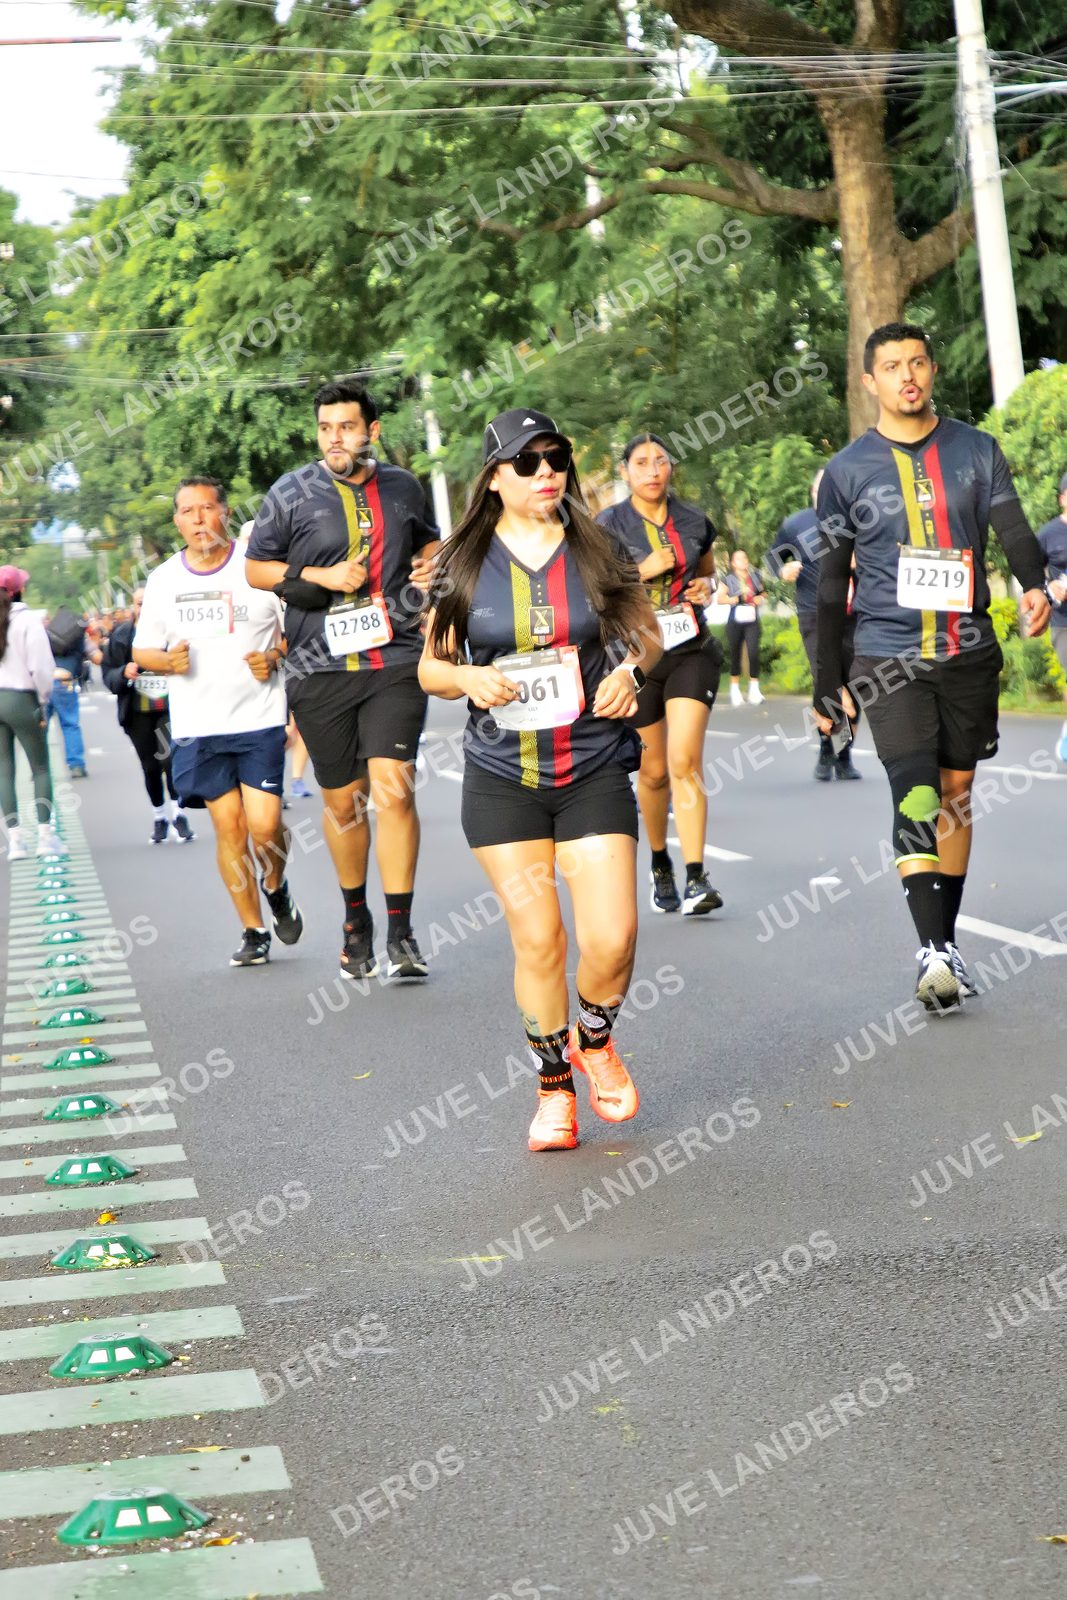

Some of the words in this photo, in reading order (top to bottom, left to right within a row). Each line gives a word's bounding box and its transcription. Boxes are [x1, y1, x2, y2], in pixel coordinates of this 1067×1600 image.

[904, 568, 965, 588] 12219
[178, 607, 224, 622] 10545
[329, 612, 380, 637] 12788
[664, 619, 690, 635] 786
[512, 675, 560, 704] 061
